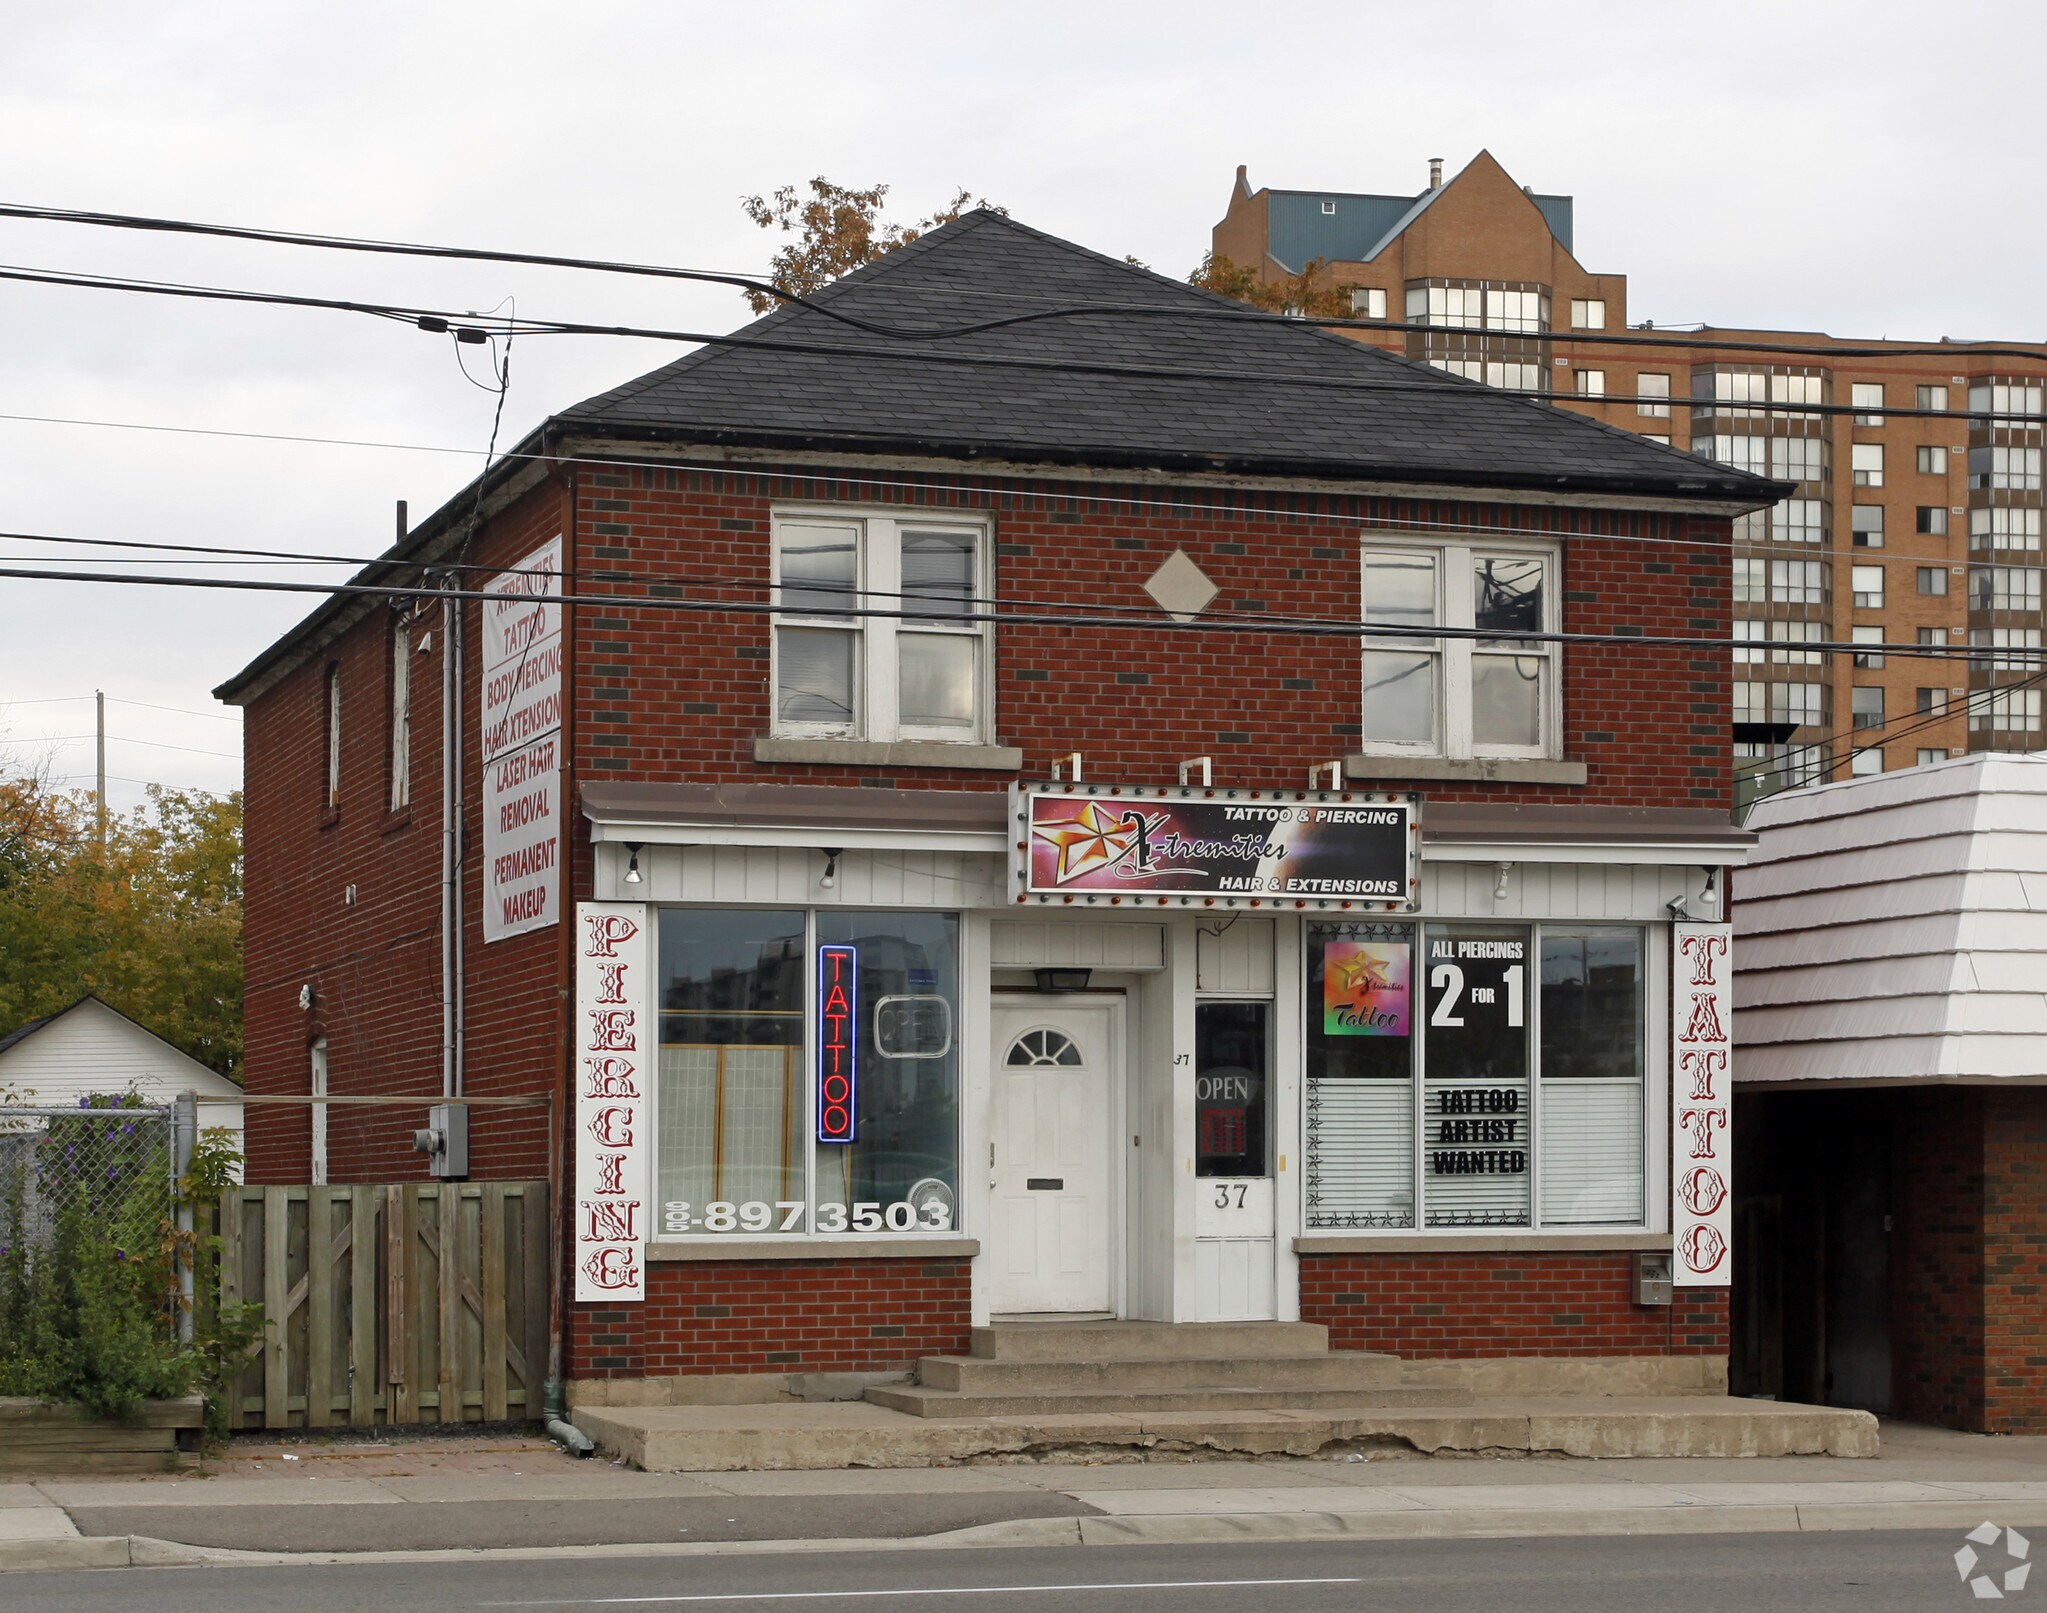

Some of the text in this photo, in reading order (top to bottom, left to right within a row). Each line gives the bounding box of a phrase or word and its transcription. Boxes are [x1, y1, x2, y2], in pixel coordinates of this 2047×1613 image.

[504, 607, 545, 655] TATTOO
[488, 669, 515, 710] BODY
[485, 718, 508, 755] HAIR
[497, 741, 554, 793] LASER HAIR
[501, 788, 549, 834] REMOVAL
[1224, 807, 1399, 825] TATTOO & PIERCING
[495, 837, 556, 886] PERMANENT
[1219, 876, 1399, 893] HAIR & EXTENSIONS
[504, 886, 546, 925] MAKEUP
[1431, 941, 1523, 960] ALL PIERCINGS
[1431, 963, 1524, 1027] 2 FOR 1
[1333, 1003, 1398, 1028] Tattoo
[823, 953, 850, 1135] TATTOO
[1173, 1054, 1189, 1066] 37
[579, 914, 641, 1289] PIERCING
[1196, 1076, 1248, 1100] OPEN
[1437, 1088, 1518, 1113] TATTOO
[1677, 933, 1728, 1274] TATTOO
[1439, 1119, 1518, 1143] ARTIST
[1433, 1151, 1525, 1174] WANTED
[1214, 1184, 1248, 1209] 37
